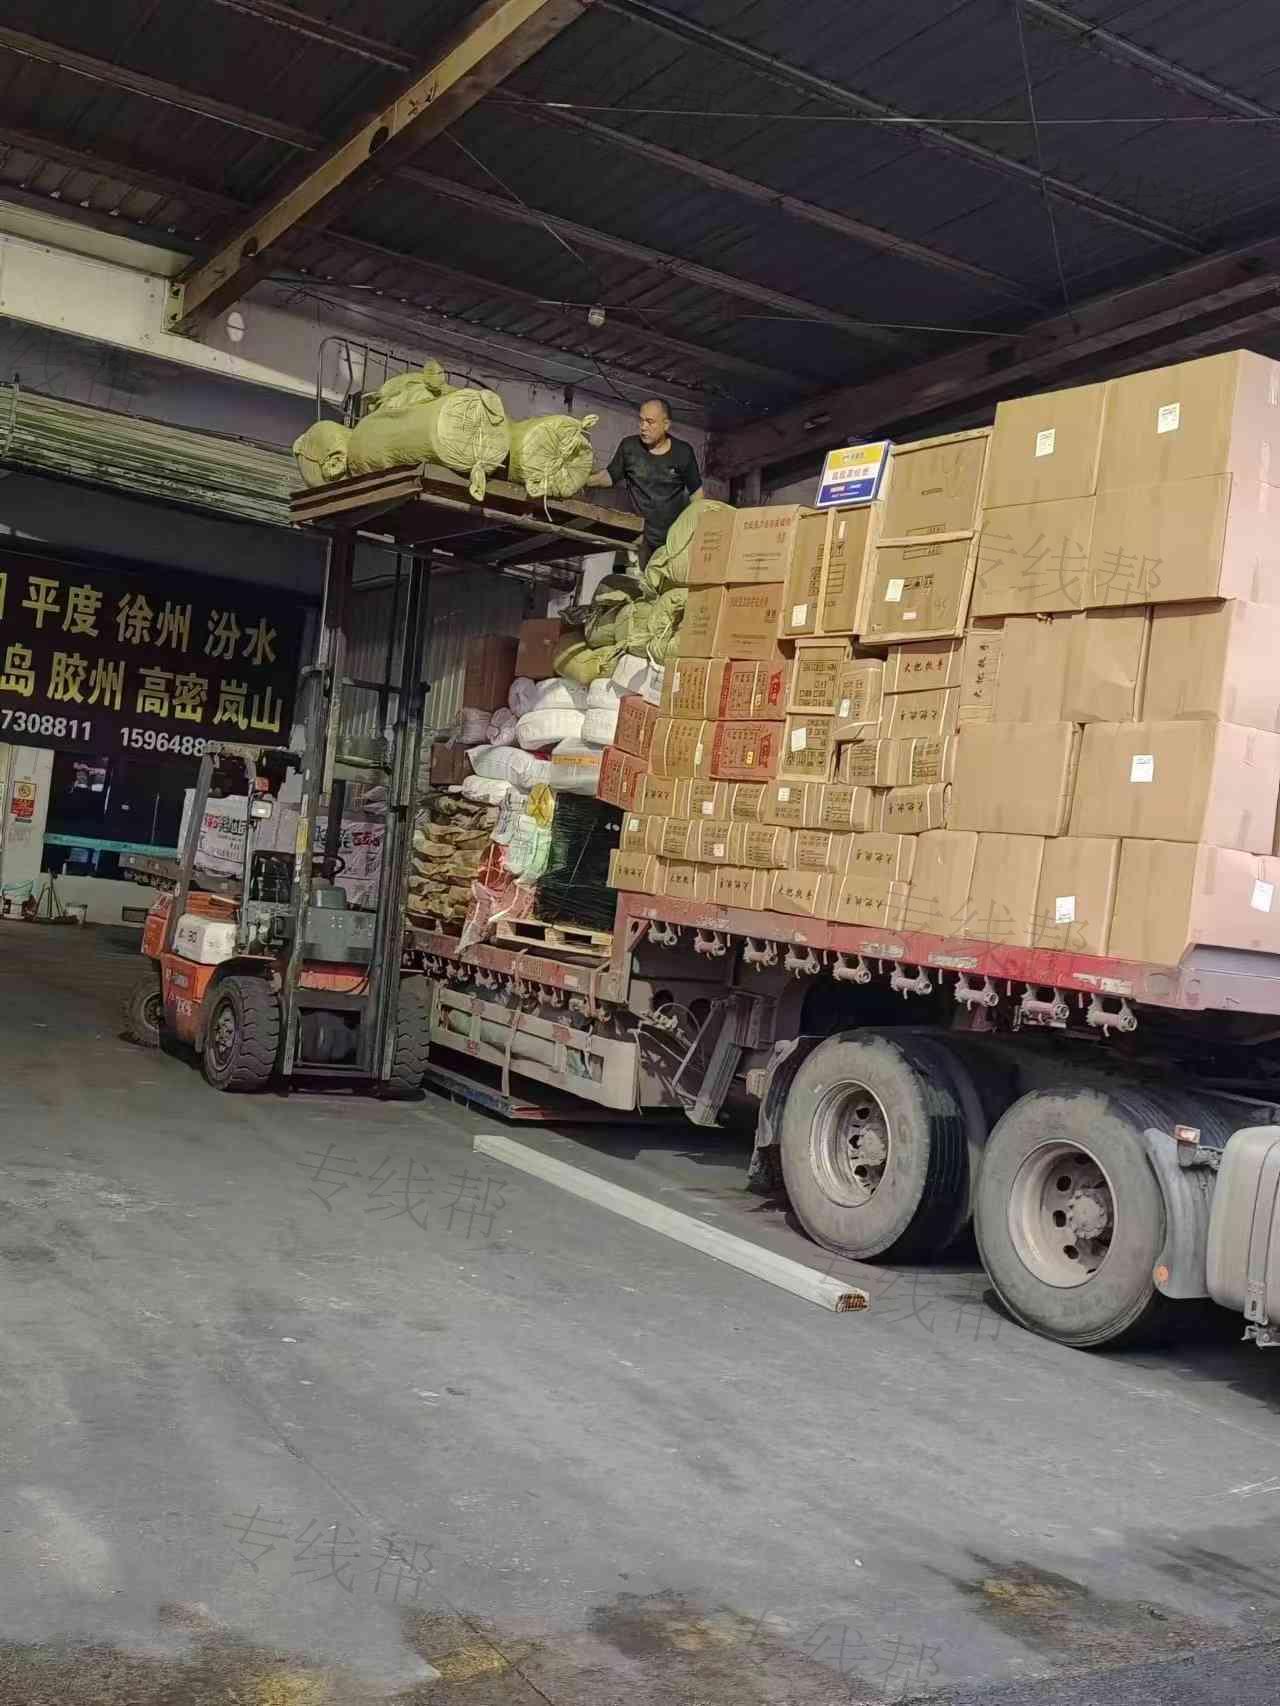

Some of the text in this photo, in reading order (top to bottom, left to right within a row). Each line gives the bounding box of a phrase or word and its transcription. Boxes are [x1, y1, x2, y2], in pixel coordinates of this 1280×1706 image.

[21, 575, 103, 638] 平度
[115, 592, 193, 653] 徐州
[204, 609, 278, 665] 汾水
[1, 709, 216, 757] 7308811 1596488
[46, 652, 127, 711] 胶州
[135, 667, 209, 724] 高密
[212, 678, 283, 733] 岚山
